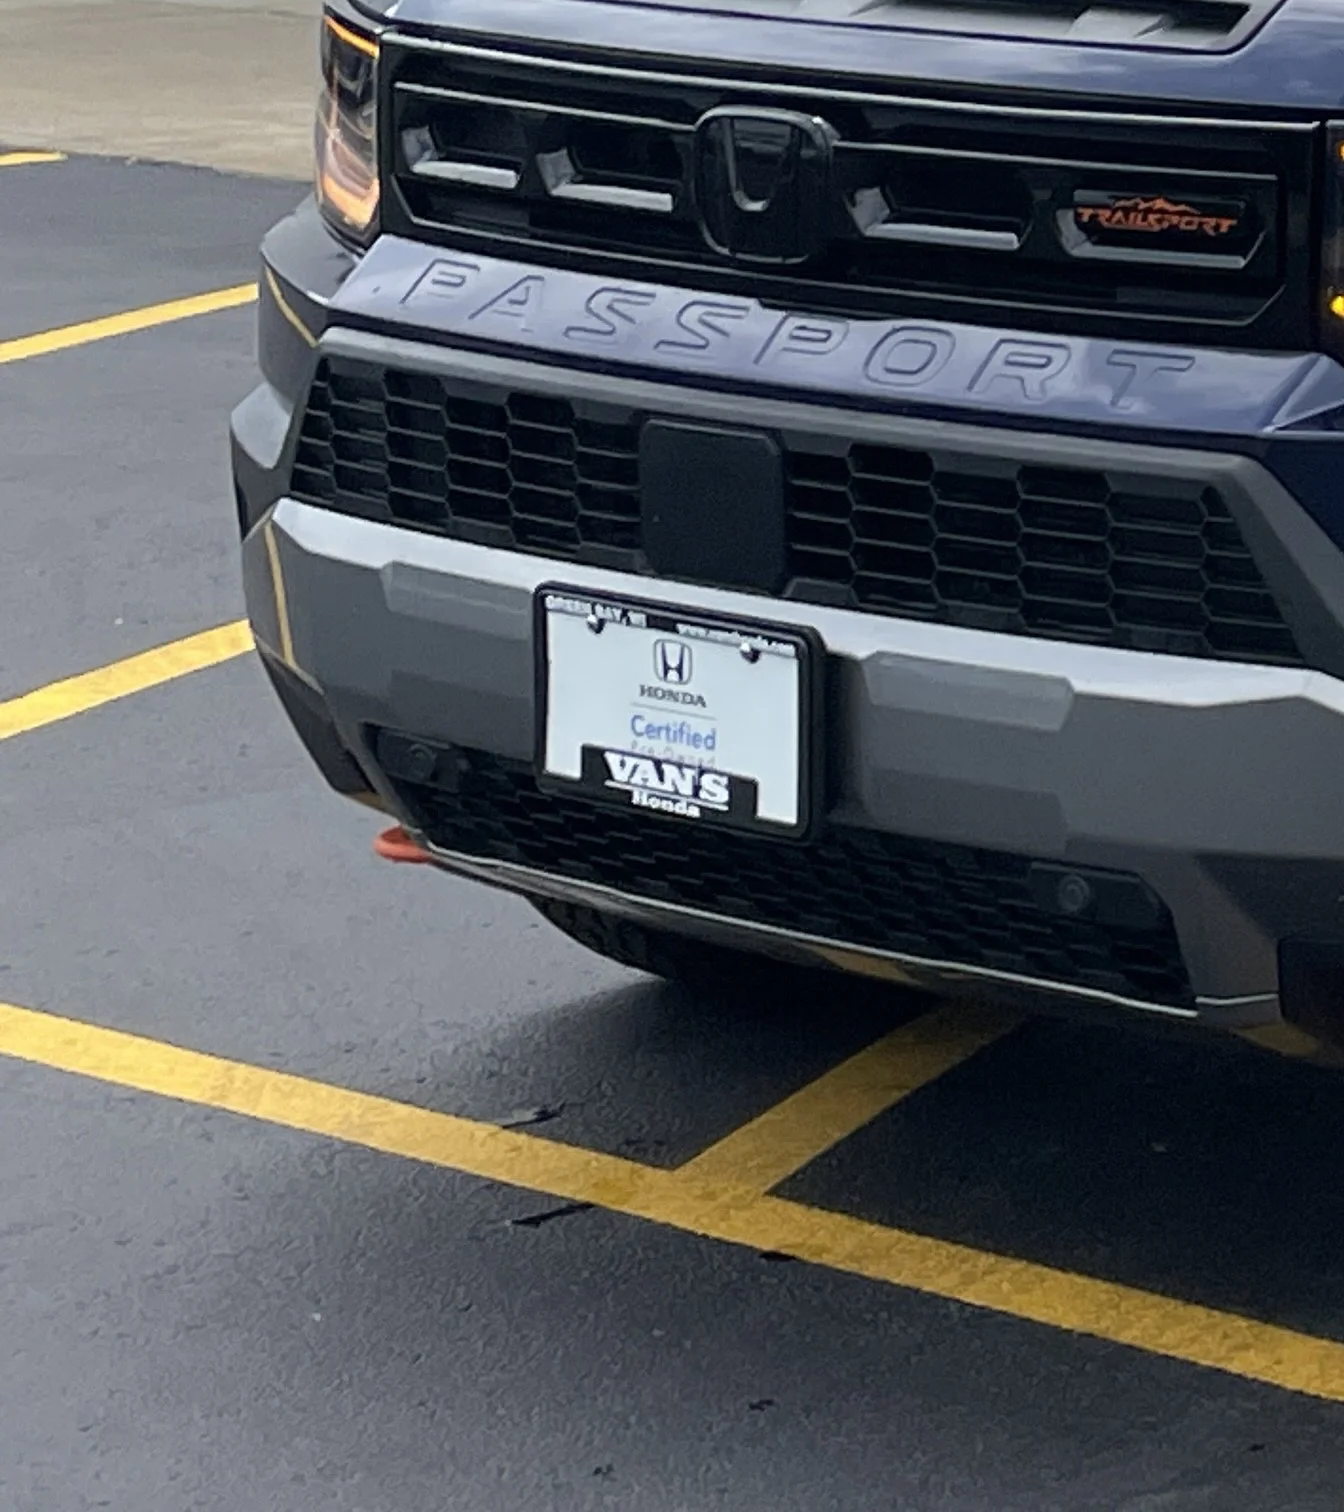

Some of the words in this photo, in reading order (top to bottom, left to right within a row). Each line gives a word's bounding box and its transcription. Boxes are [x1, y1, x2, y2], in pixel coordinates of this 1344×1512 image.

[1076, 206, 1238, 237] TRAILSPORT
[398, 255, 1196, 410] PASSPORT
[638, 684, 707, 709] HONDA
[630, 714, 717, 752] Certified
[631, 790, 701, 819] Honda
